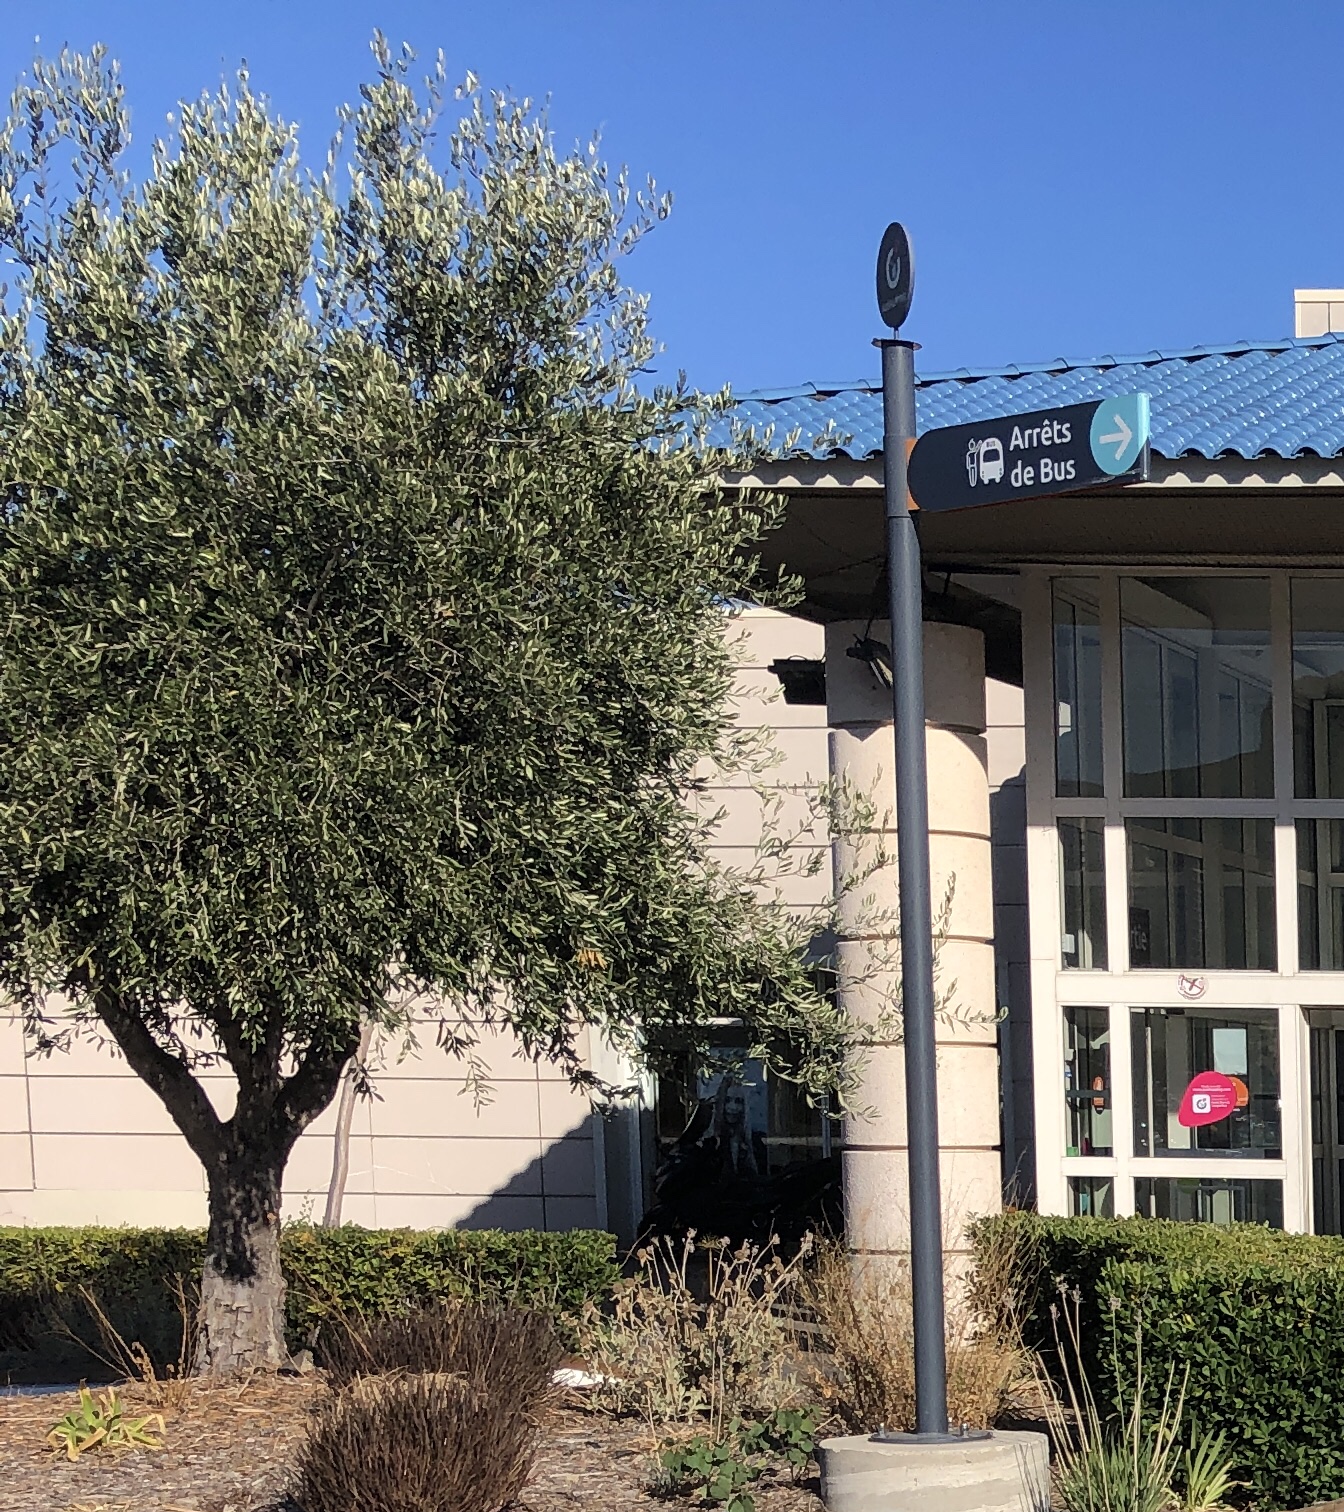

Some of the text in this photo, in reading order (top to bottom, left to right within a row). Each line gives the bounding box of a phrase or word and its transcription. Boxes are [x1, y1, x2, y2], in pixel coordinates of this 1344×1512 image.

[1009, 419, 1072, 451] Arrêts
[1010, 457, 1076, 488] de Bus
